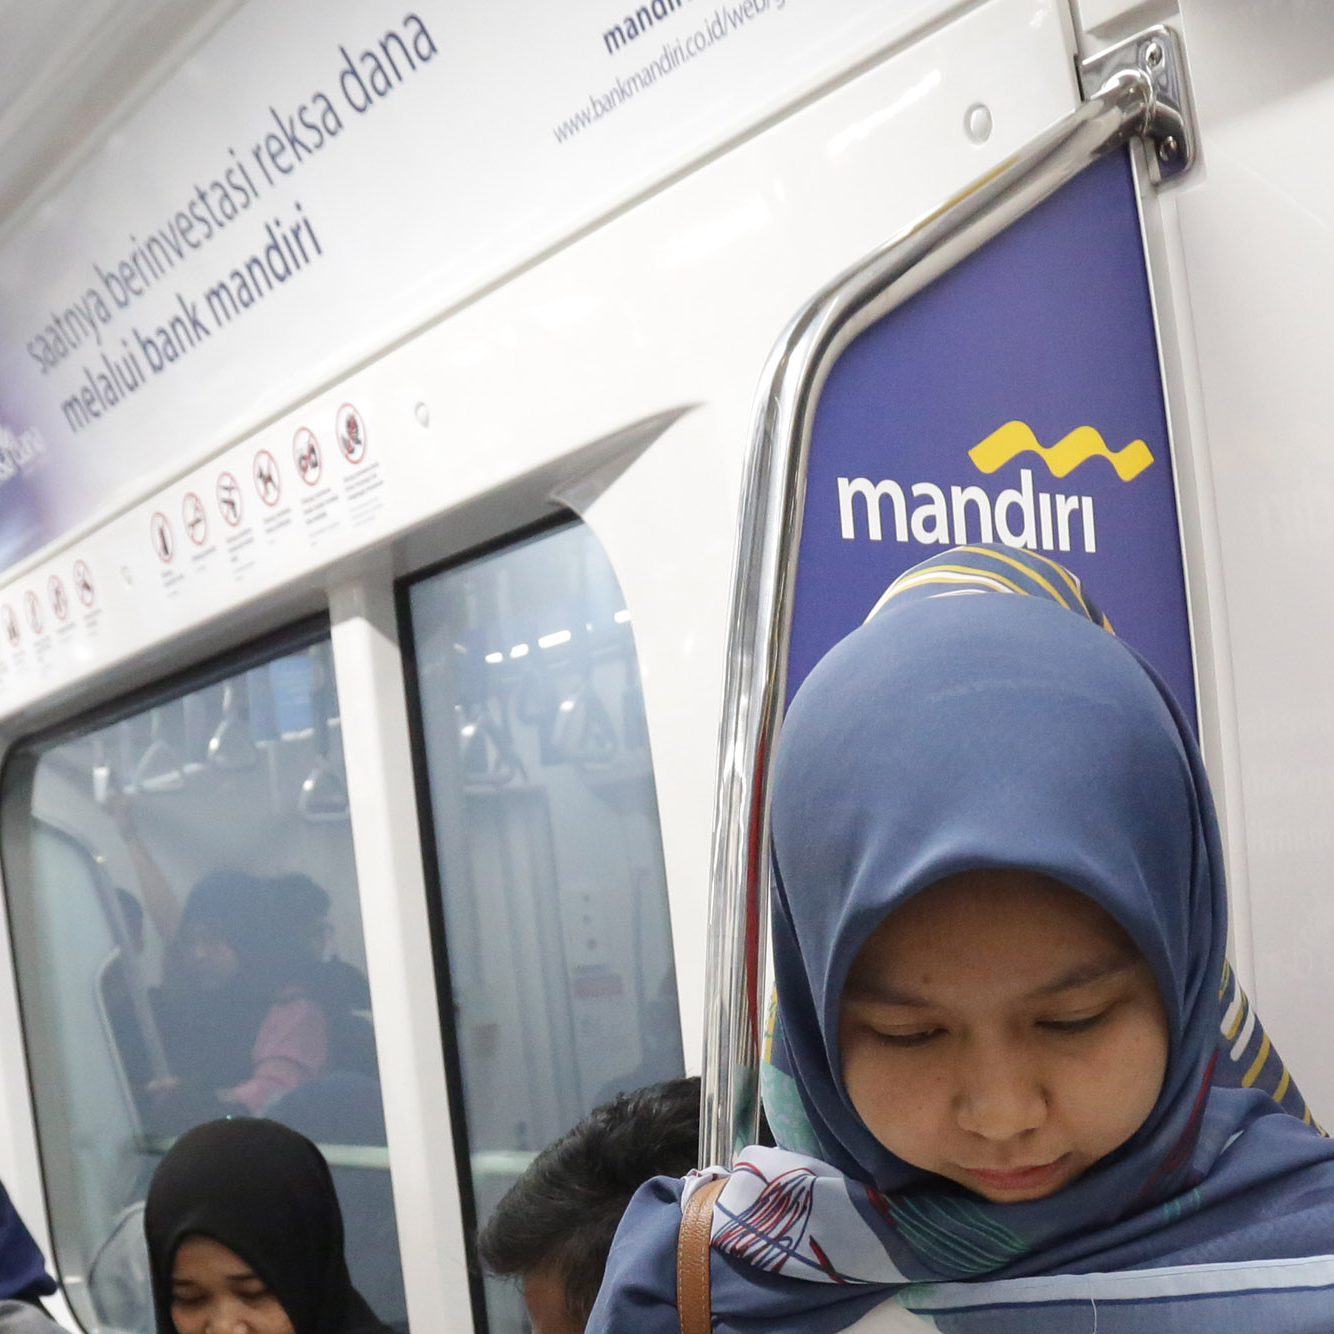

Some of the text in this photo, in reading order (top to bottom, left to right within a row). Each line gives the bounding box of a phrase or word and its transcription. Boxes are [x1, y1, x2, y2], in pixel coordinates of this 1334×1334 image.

[25, 11, 439, 375] saatnya berinvestasi reksa dana
[60, 202, 324, 433] melalui bank mandiri
[835, 467, 1097, 554] mandiri
